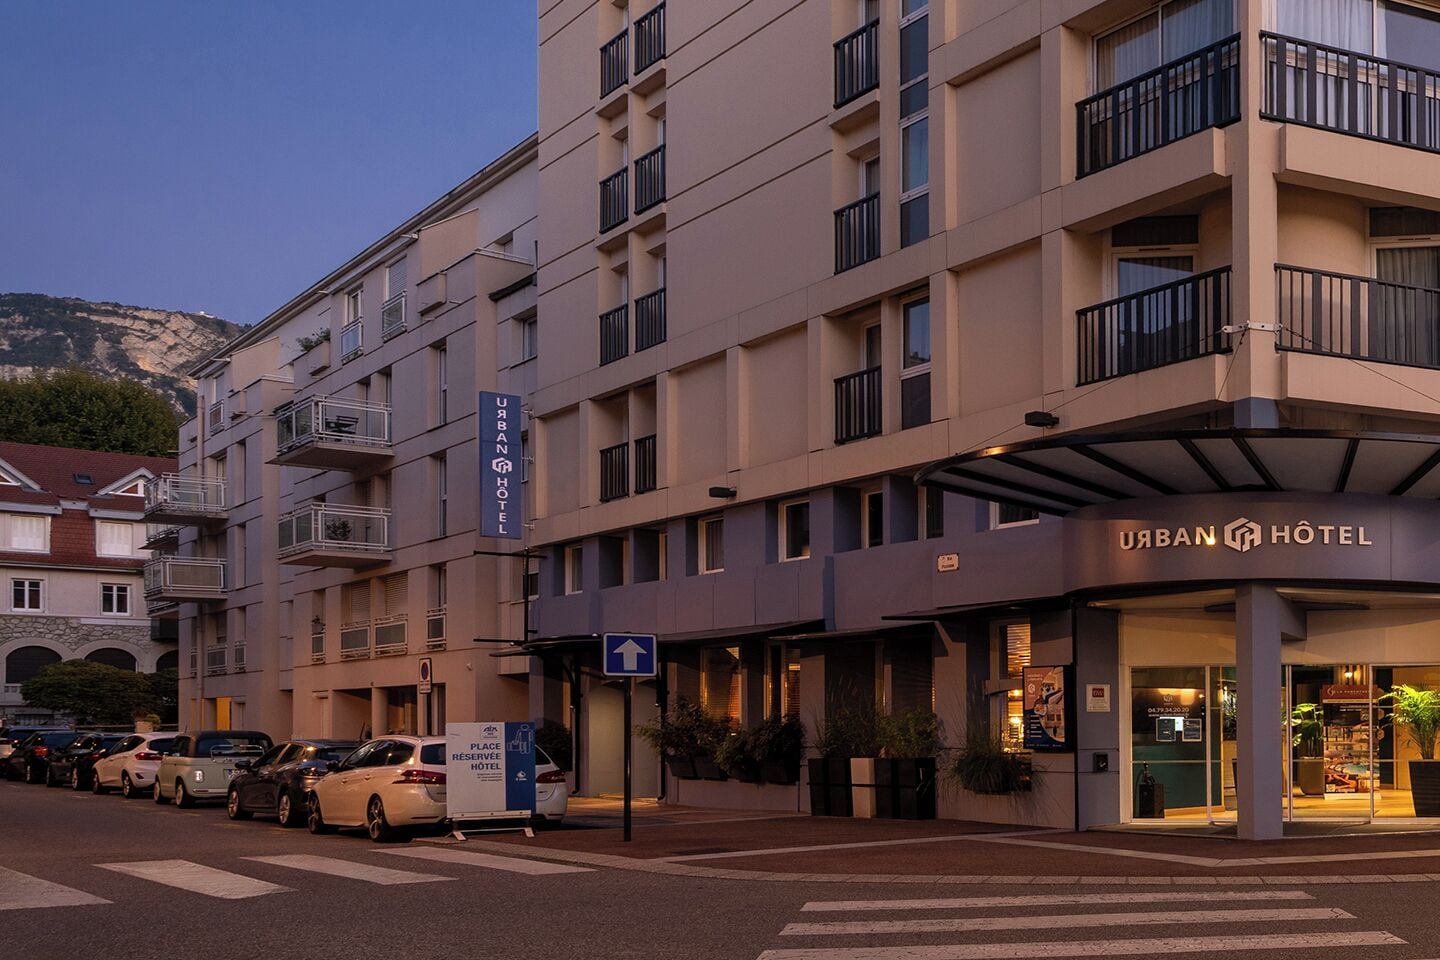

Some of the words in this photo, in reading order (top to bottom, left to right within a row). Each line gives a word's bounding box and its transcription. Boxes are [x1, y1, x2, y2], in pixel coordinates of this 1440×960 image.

[496, 397, 508, 454] URBAN
[496, 477, 508, 534] HÔTEL
[1119, 525, 1216, 550] URBAN
[1271, 520, 1373, 545] HÔTEL
[452, 752, 501, 760] RÉSERVÉE
[471, 762, 501, 770] HÔTEL
